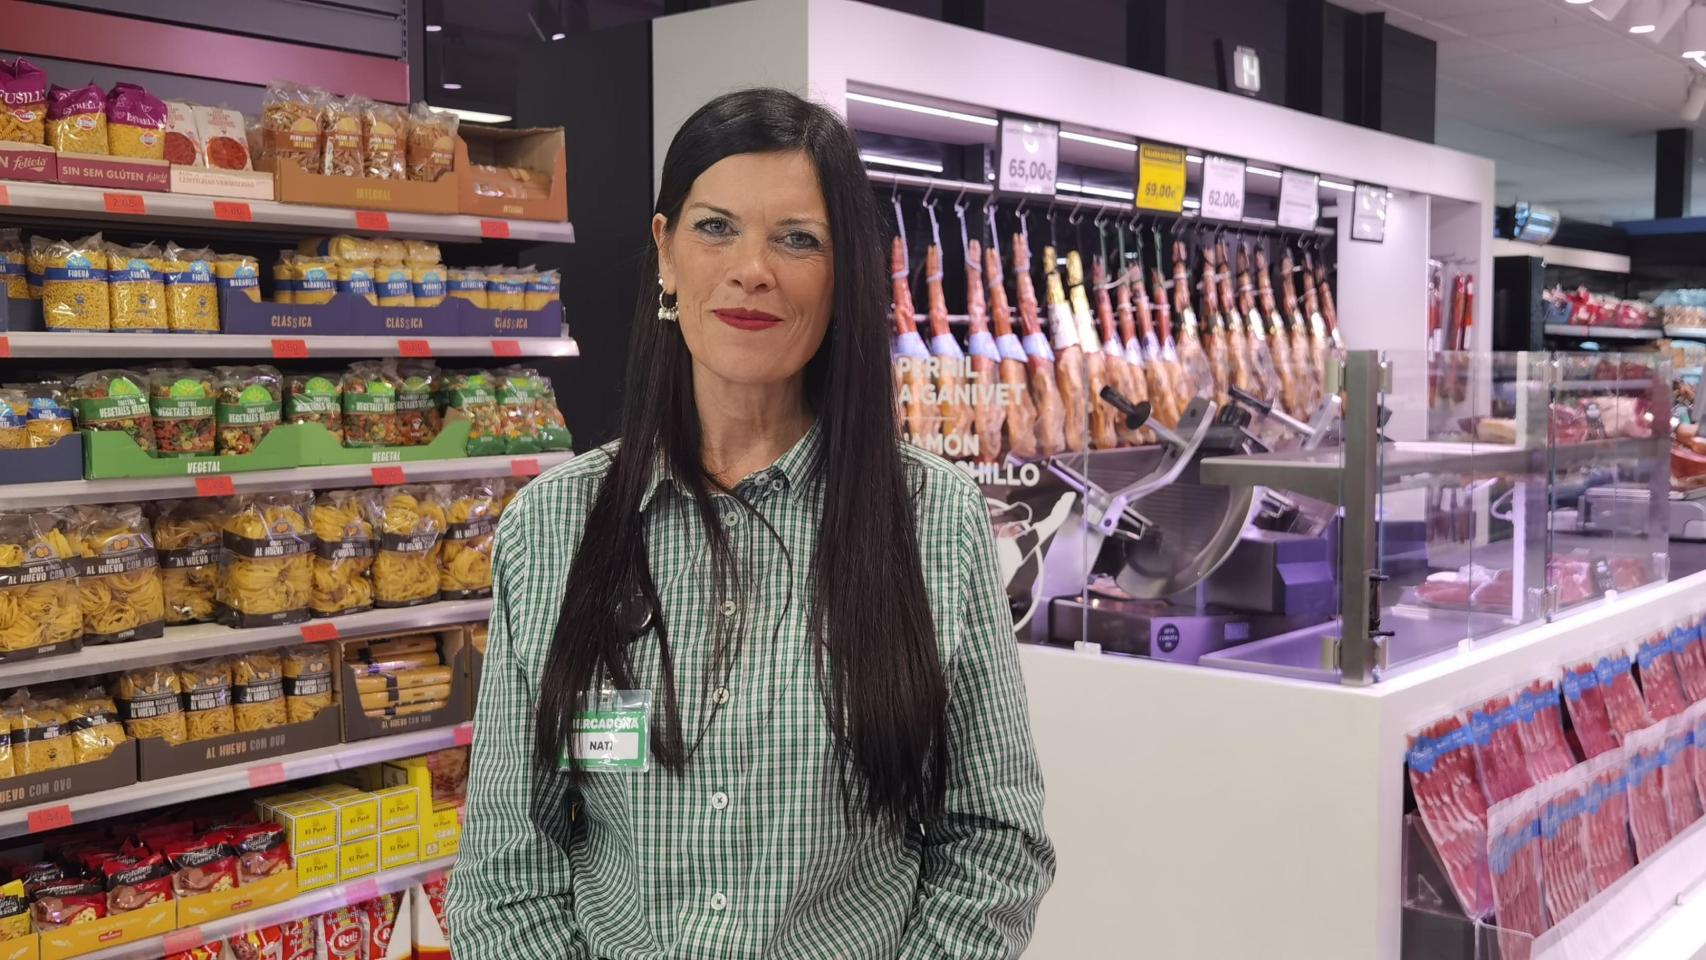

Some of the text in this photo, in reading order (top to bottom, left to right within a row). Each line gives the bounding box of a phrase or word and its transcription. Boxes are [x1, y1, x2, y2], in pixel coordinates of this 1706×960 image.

[13, 155, 48, 172] felicia
[1008, 158, 1052, 182] 65,00€
[62, 166, 80, 176] SIN
[83, 168, 104, 178] SEM
[106, 169, 144, 182] GLÚTEN
[356, 188, 392, 200] INTEGRAL
[898, 355, 980, 378] PERNIL
[900, 383, 1026, 406] A GANIVET
[904, 426, 980, 457] AMÓN
[372, 450, 400, 462] VEGETAL
[187, 462, 221, 474] VEGETAL
[455, 530, 462, 538] AL
[254, 548, 263, 557] AL
[265, 546, 284, 556] HUEVO
[86, 566, 96, 576] AL
[98, 563, 124, 574] HUEVO
[126, 560, 141, 570] COM
[176, 557, 185, 567] AL
[186, 555, 208, 566] HUEVO
[8, 576, 17, 585] AL
[20, 572, 46, 584] HUEVO
[138, 708, 156, 717] HUEVO
[206, 734, 286, 760] AL HUEVO COM OVO
[0, 778, 72, 804] UEVO COM OVO
